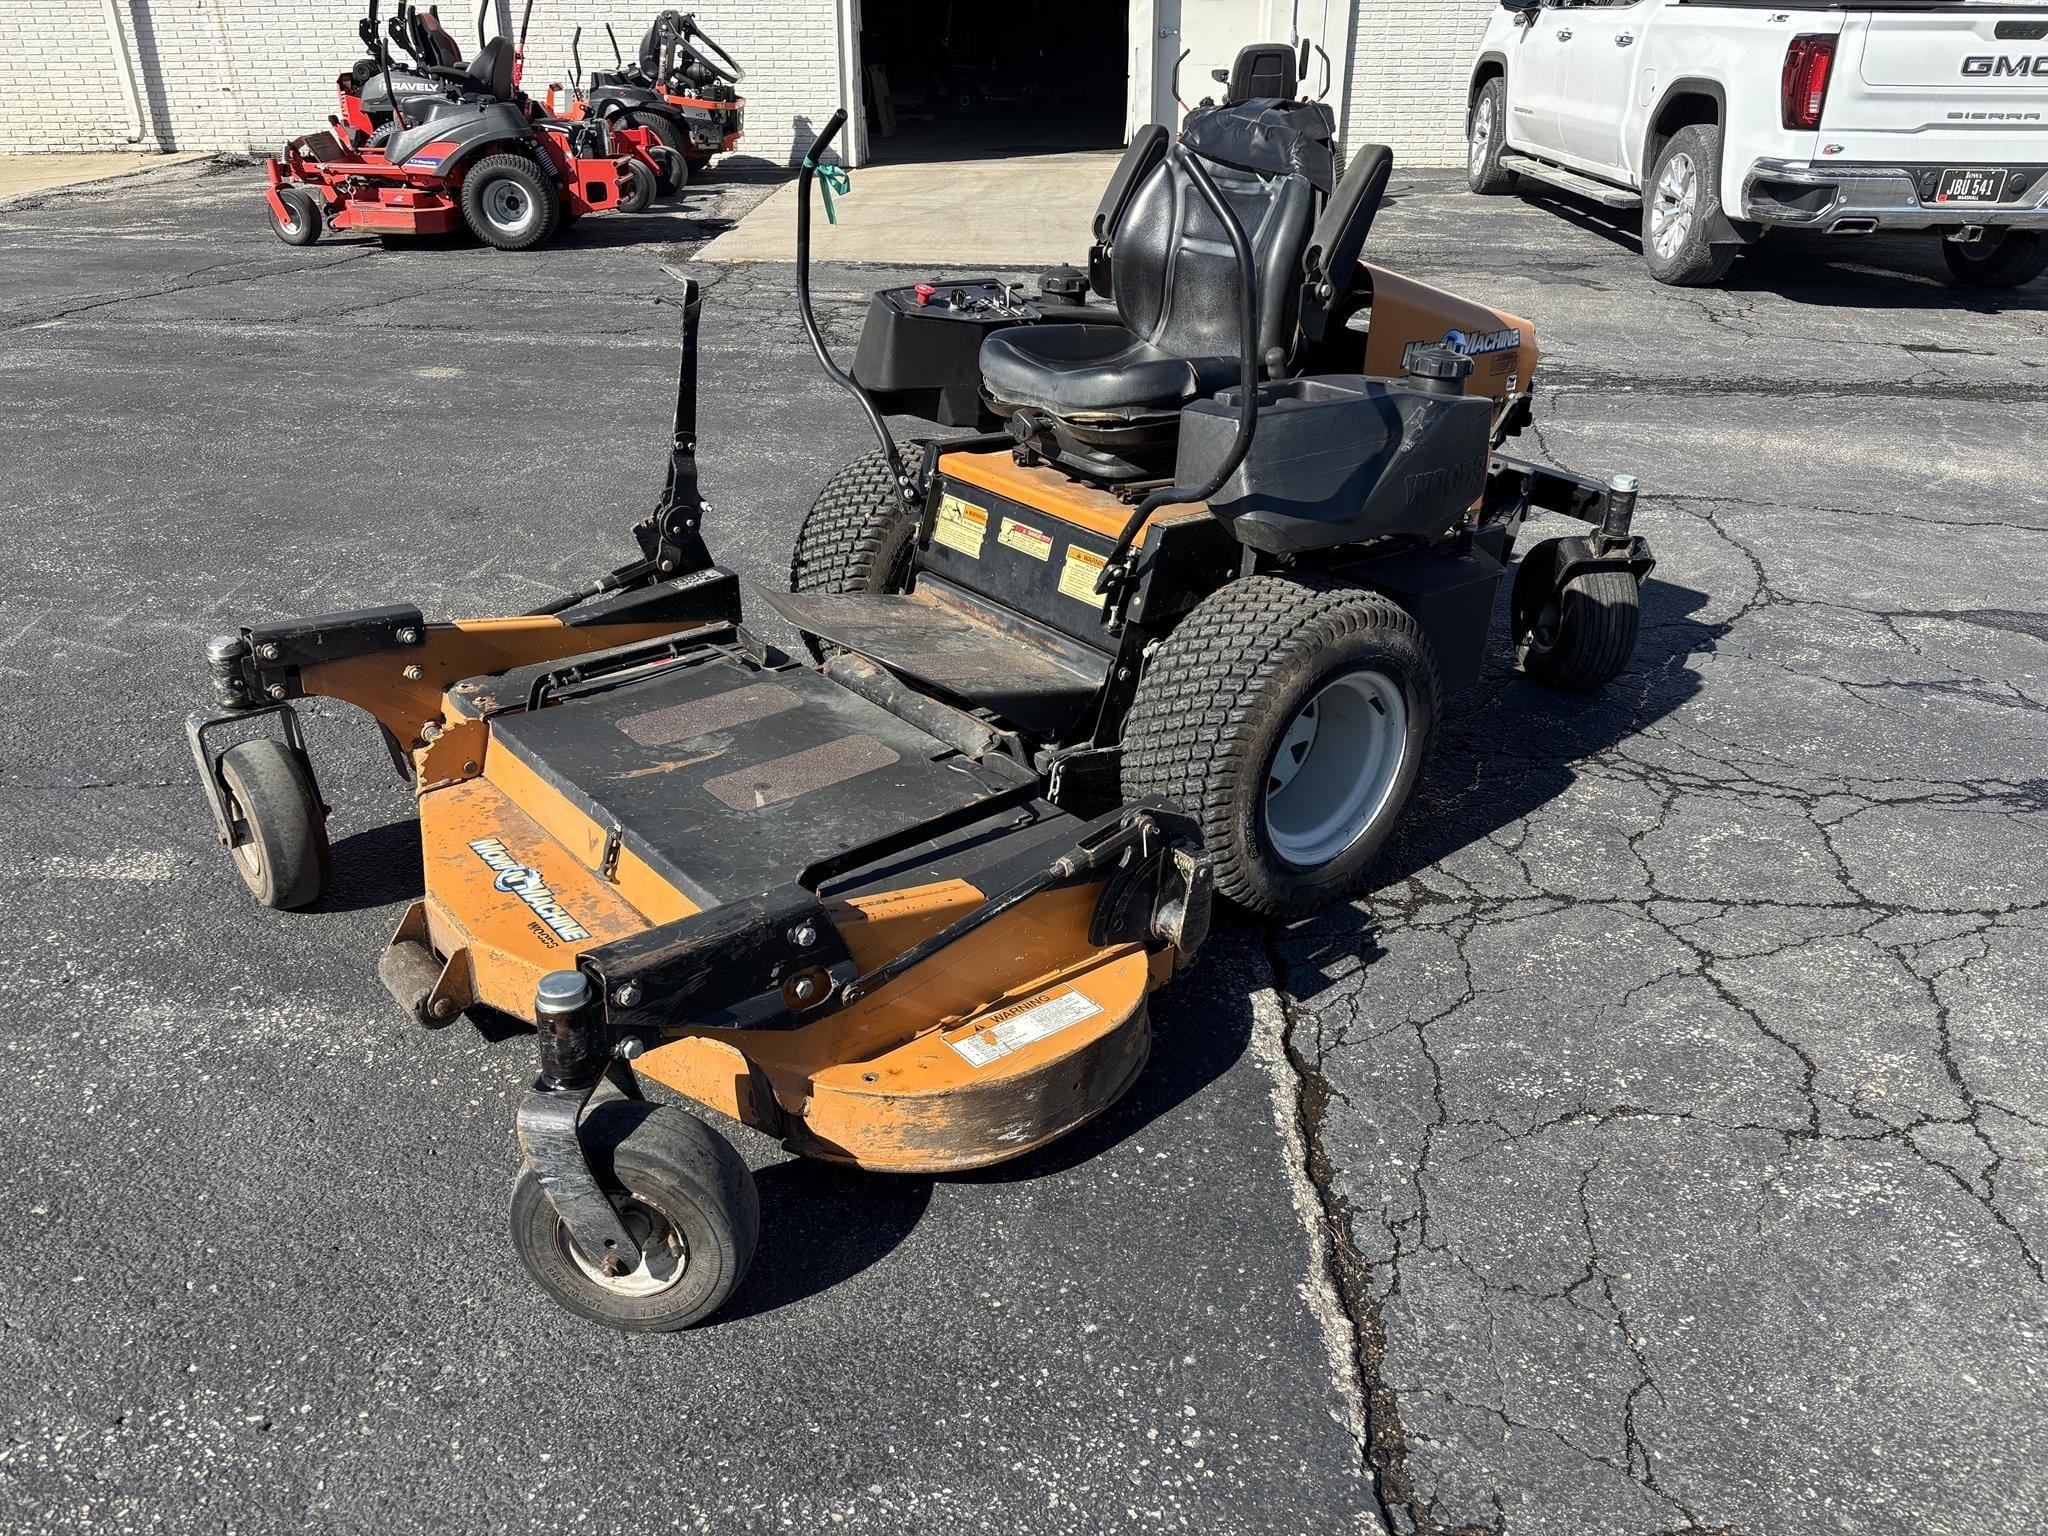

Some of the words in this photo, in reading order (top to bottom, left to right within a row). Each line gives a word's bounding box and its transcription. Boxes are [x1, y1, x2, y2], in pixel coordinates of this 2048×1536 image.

[1946, 112, 2041, 121] SIERRA
[1946, 178, 1971, 196] JBU
[1971, 178, 1994, 196] 541
[513, 880, 593, 943] MACHINE
[527, 921, 560, 949] WOODS
[990, 994, 1051, 1023] WARNING
